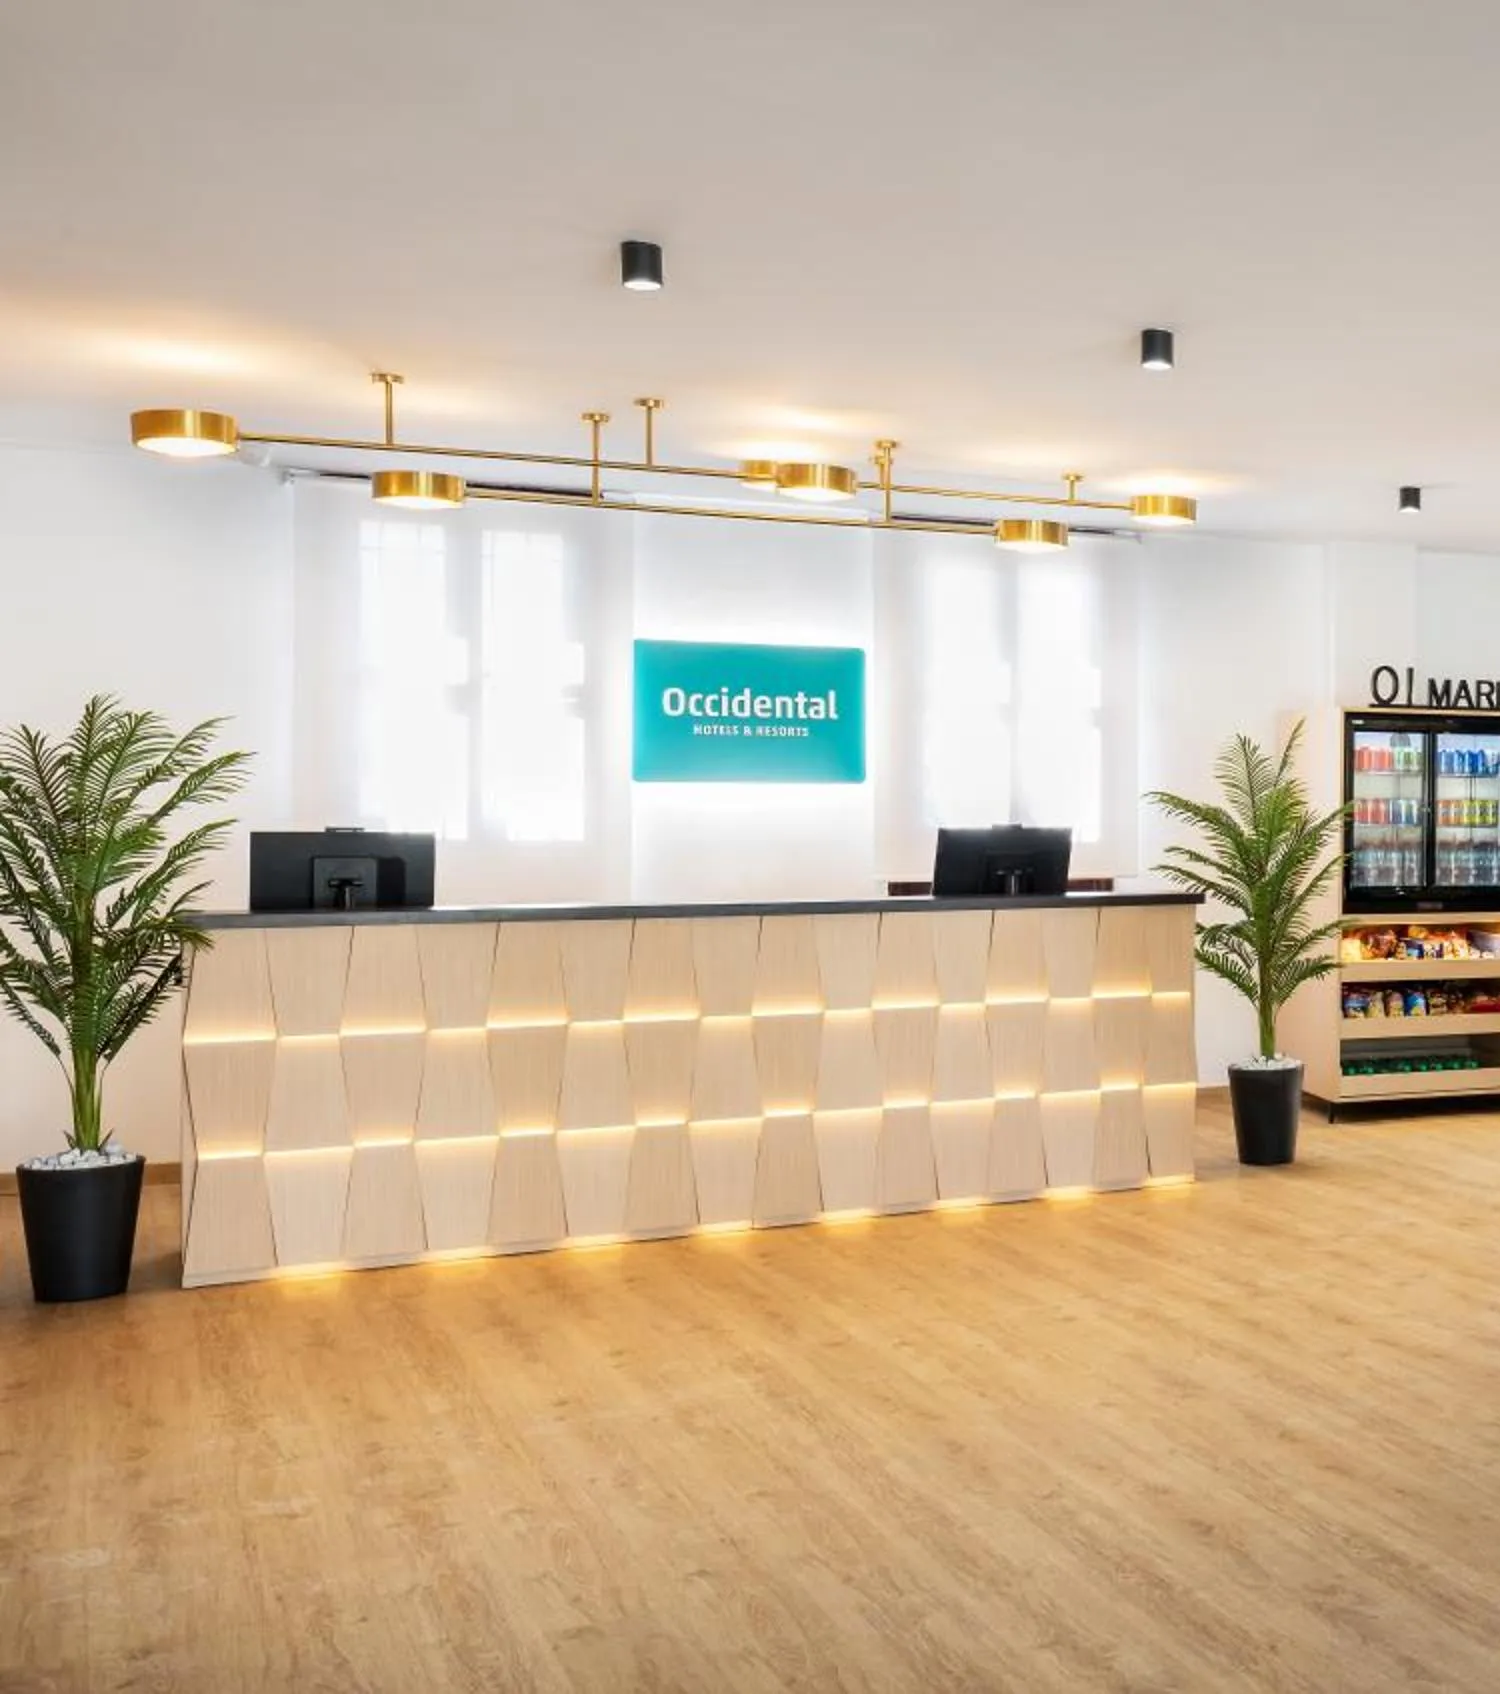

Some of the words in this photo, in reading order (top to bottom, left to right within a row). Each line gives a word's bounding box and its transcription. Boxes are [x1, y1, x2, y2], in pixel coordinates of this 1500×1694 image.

[662, 686, 839, 720] Occidental
[693, 724, 739, 736] HOTELS
[743, 725, 752, 737] &
[756, 726, 809, 737] RESORTS
